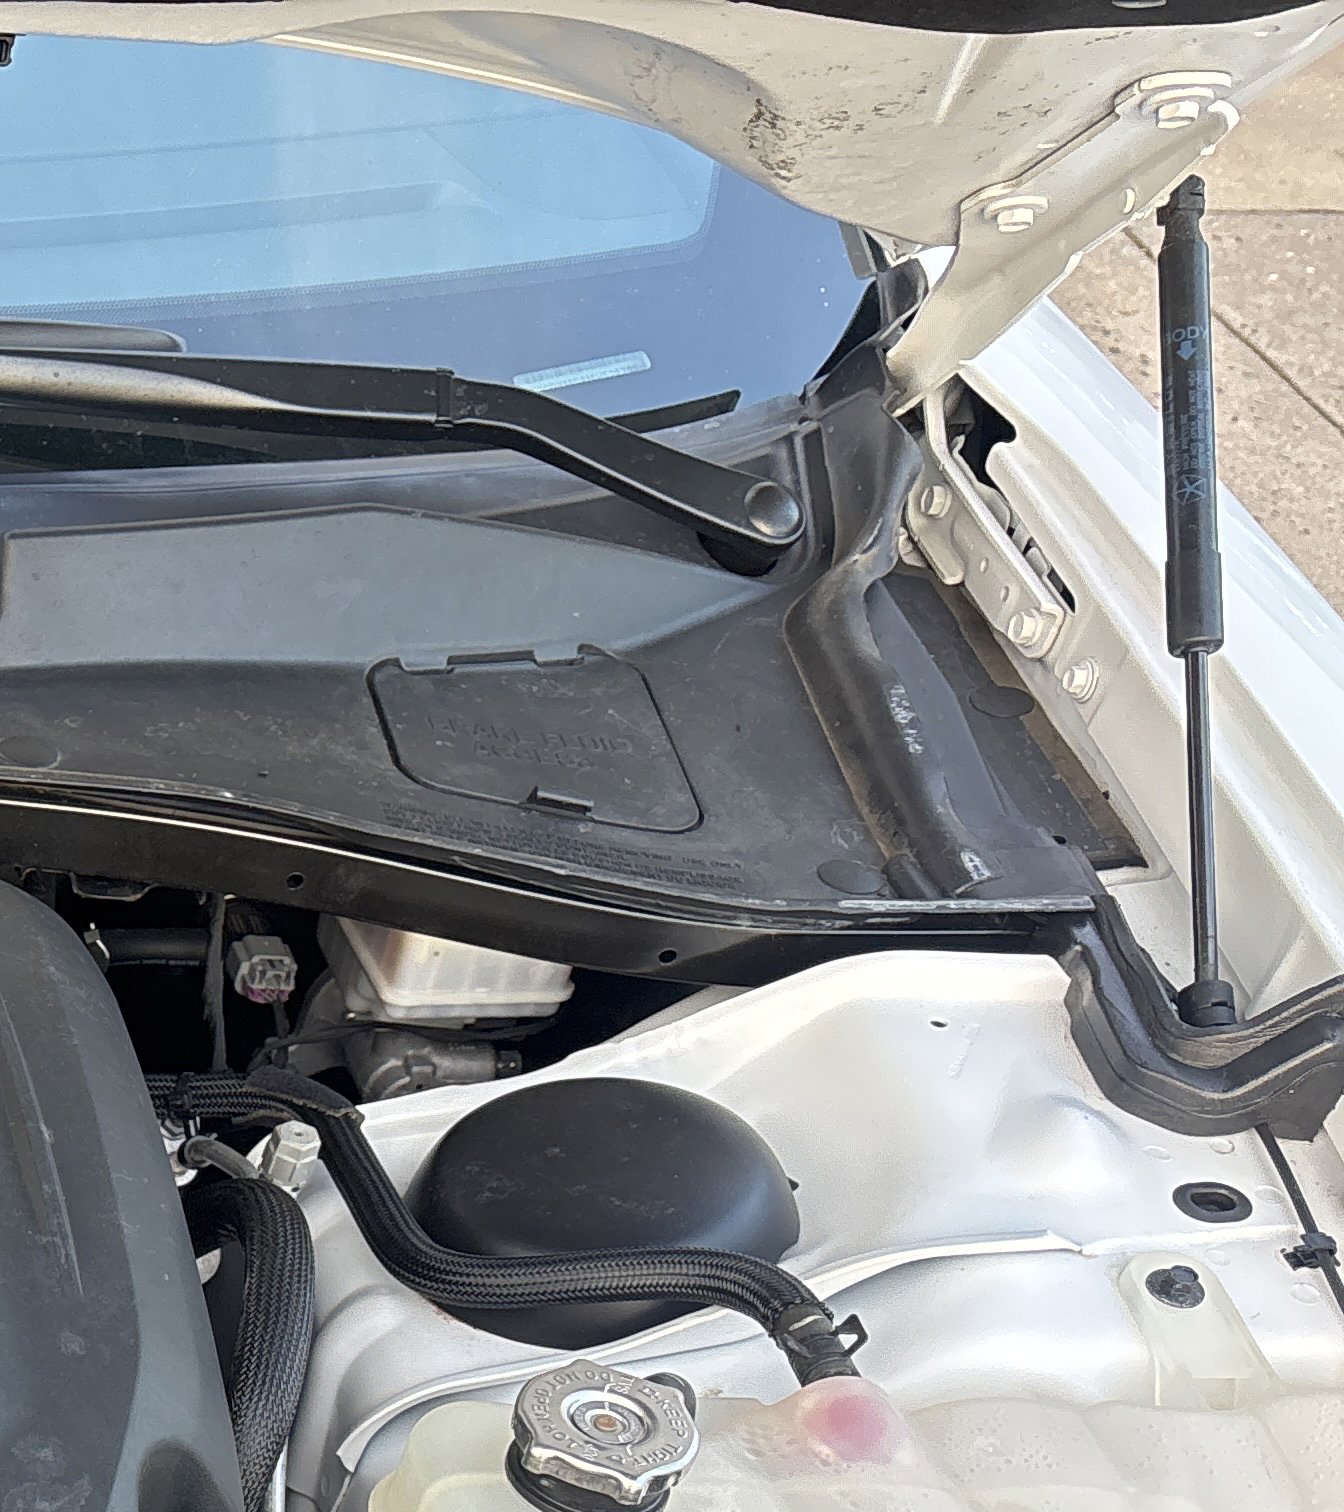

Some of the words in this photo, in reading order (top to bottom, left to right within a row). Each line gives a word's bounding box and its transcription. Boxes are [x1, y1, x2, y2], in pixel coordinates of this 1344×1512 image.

[548, 1370, 582, 1391] NOT
[532, 1388, 552, 1421] OPEN
[660, 1398, 689, 1439] KEEP
[633, 1443, 684, 1467] TIGHT
